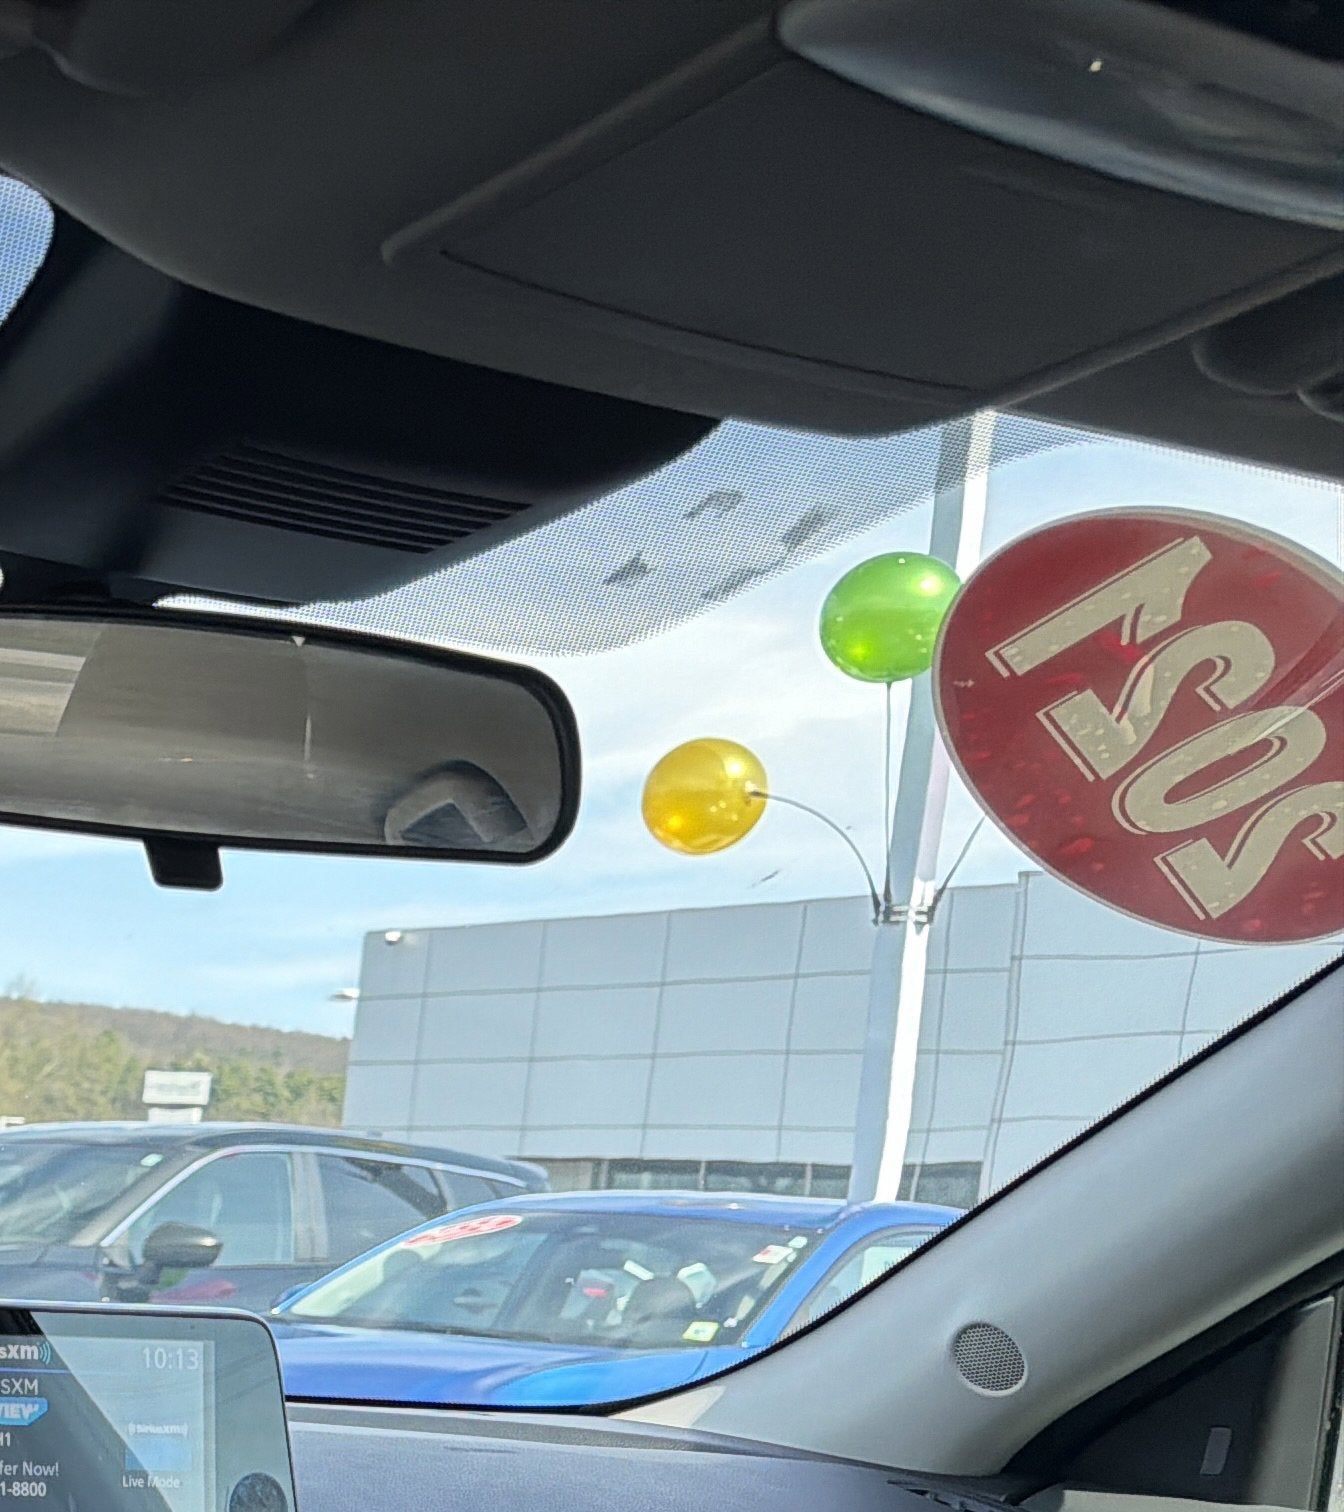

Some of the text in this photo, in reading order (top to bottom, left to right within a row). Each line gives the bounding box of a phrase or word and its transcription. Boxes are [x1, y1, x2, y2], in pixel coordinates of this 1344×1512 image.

[142, 1347, 200, 1370] 10:13
[22, 1460, 60, 1477] Now!
[122, 1475, 181, 1489] Live Mode
